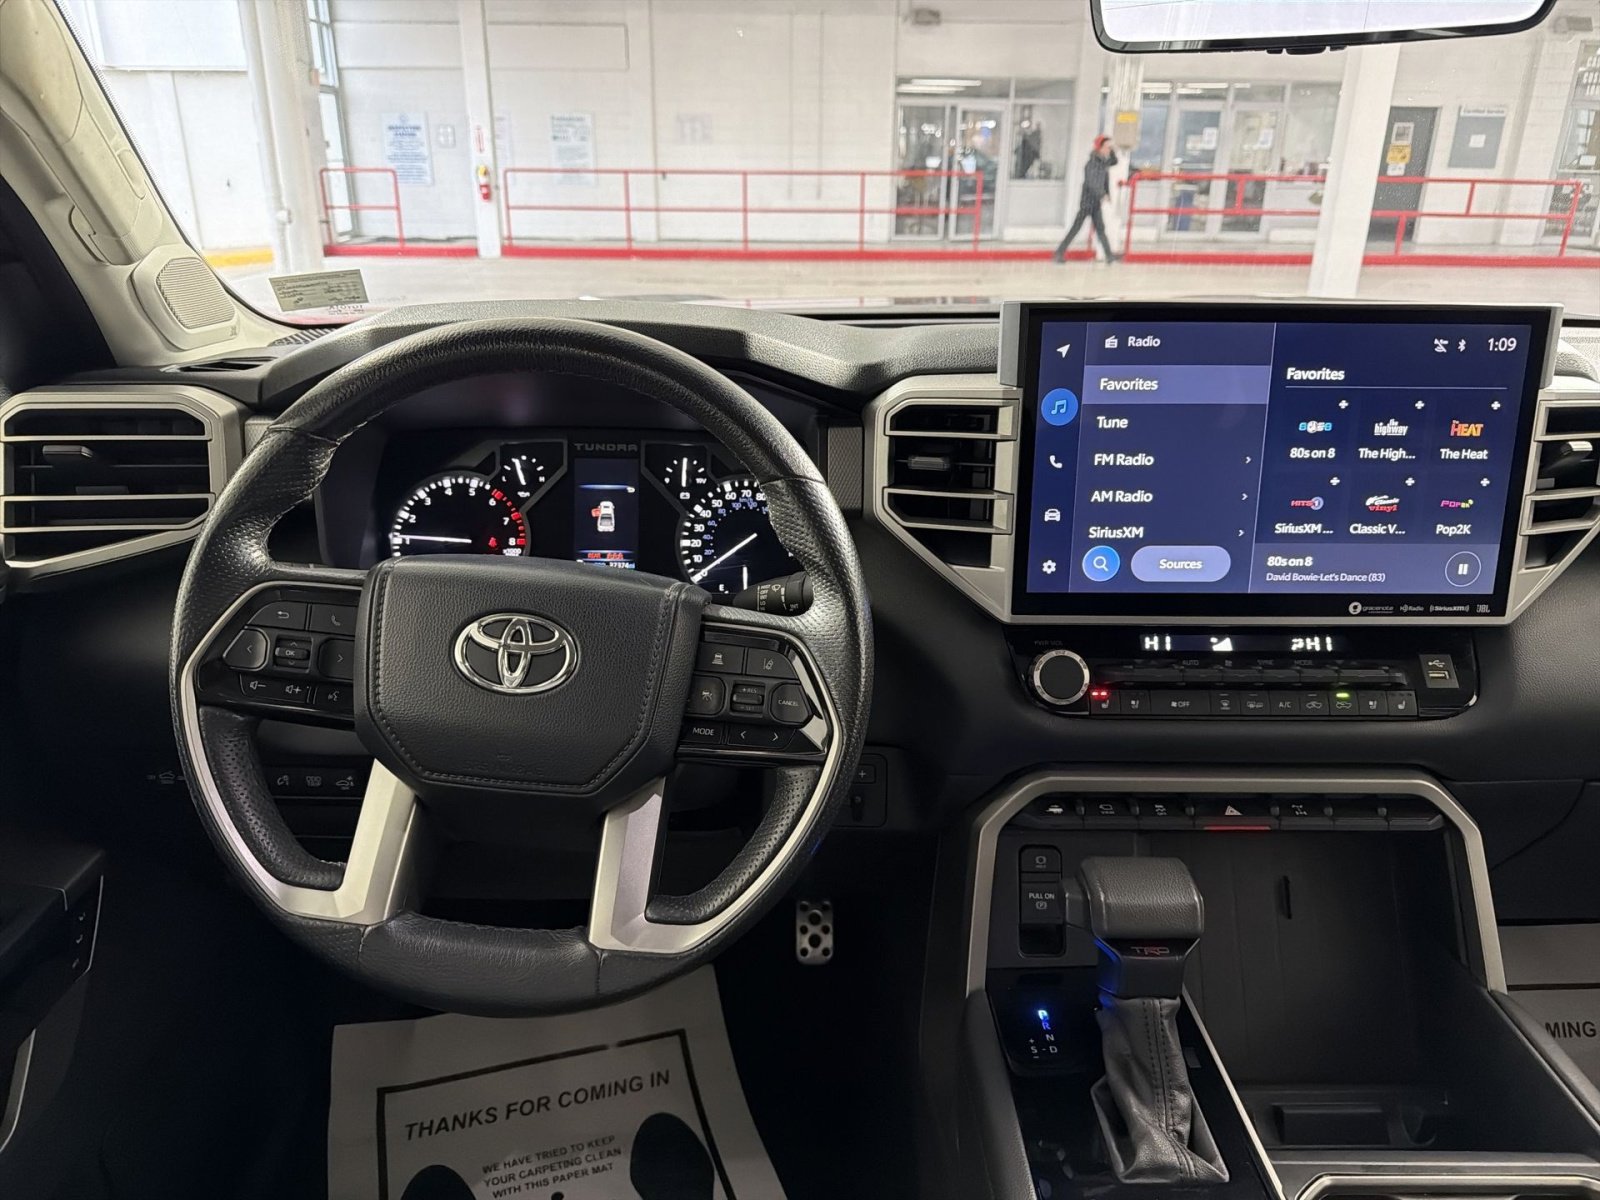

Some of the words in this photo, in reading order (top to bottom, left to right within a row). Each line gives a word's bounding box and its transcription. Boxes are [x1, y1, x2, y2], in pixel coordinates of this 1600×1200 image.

[1127, 336, 1161, 348] Radio
[1487, 338, 1518, 352] 1:09
[1286, 367, 1345, 380] Favorites
[1100, 378, 1158, 391] Favorites
[1096, 416, 1128, 428] Tune
[1450, 423, 1484, 437] HEAT
[574, 443, 638, 452] TUNDRA
[1290, 447, 1311, 458] 80s
[1311, 450, 1326, 458] on
[1327, 447, 1336, 458] 8
[1358, 447, 1379, 458] The
[1440, 448, 1460, 460] The
[1461, 448, 1488, 460] Heat
[1094, 454, 1114, 466] FM
[1116, 454, 1154, 466] Radio
[444, 488, 453, 496] 4
[468, 488, 476, 496] 5
[724, 492, 737, 500] 60
[740, 490, 752, 498] 70
[1091, 491, 1113, 502] AM
[1115, 490, 1153, 502] Radio
[424, 497, 432, 506] 3
[488, 498, 497, 506] 6
[712, 500, 723, 508] 50
[408, 514, 417, 524] 2
[700, 510, 712, 518] 40
[503, 517, 510, 526] 7
[694, 524, 705, 532] 30
[1088, 526, 1144, 538] SiriusXM
[1274, 524, 1321, 535] SiriusXM
[1350, 524, 1384, 535] Classic
[1436, 524, 1472, 536] Pop2K
[508, 538, 516, 546] 8
[690, 539, 702, 548] 20
[692, 554, 703, 563] 10
[1266, 556, 1288, 567] 80s
[1288, 558, 1304, 567] on
[1304, 556, 1314, 567] 8
[1159, 559, 1202, 570] Sources
[1266, 572, 1292, 582] David
[1340, 573, 1368, 582] Dance
[1368, 573, 1386, 583] (83)
[718, 584, 725, 592] E
[1476, 604, 1490, 613] JBL
[1144, 635, 1172, 651] HI
[692, 728, 715, 736] MODE
[1028, 892, 1044, 900] PULL
[1130, 946, 1170, 956] TRD
[1042, 1021, 1051, 1030] R
[1045, 1034, 1055, 1042] N
[1030, 1046, 1038, 1054] S
[1049, 1046, 1058, 1054] D
[404, 1107, 498, 1141] THANKS
[505, 1096, 551, 1120] FOR
[558, 1076, 643, 1108] COMING
[650, 1069, 670, 1088] IN
[482, 1162, 500, 1174] WE
[504, 1154, 533, 1170] HAVE
[535, 1146, 568, 1162] TRIED
[570, 1142, 585, 1152] TO
[587, 1135, 616, 1150] KEEP
[484, 1173, 516, 1188] YOUR
[518, 1156, 583, 1180] CARPETING
[584, 1148, 622, 1163] CLEAN
[492, 1185, 522, 1200] WITH
[524, 1178, 550, 1192] THIS
[552, 1169, 590, 1184] PAPER
[592, 1162, 615, 1175] MAT
